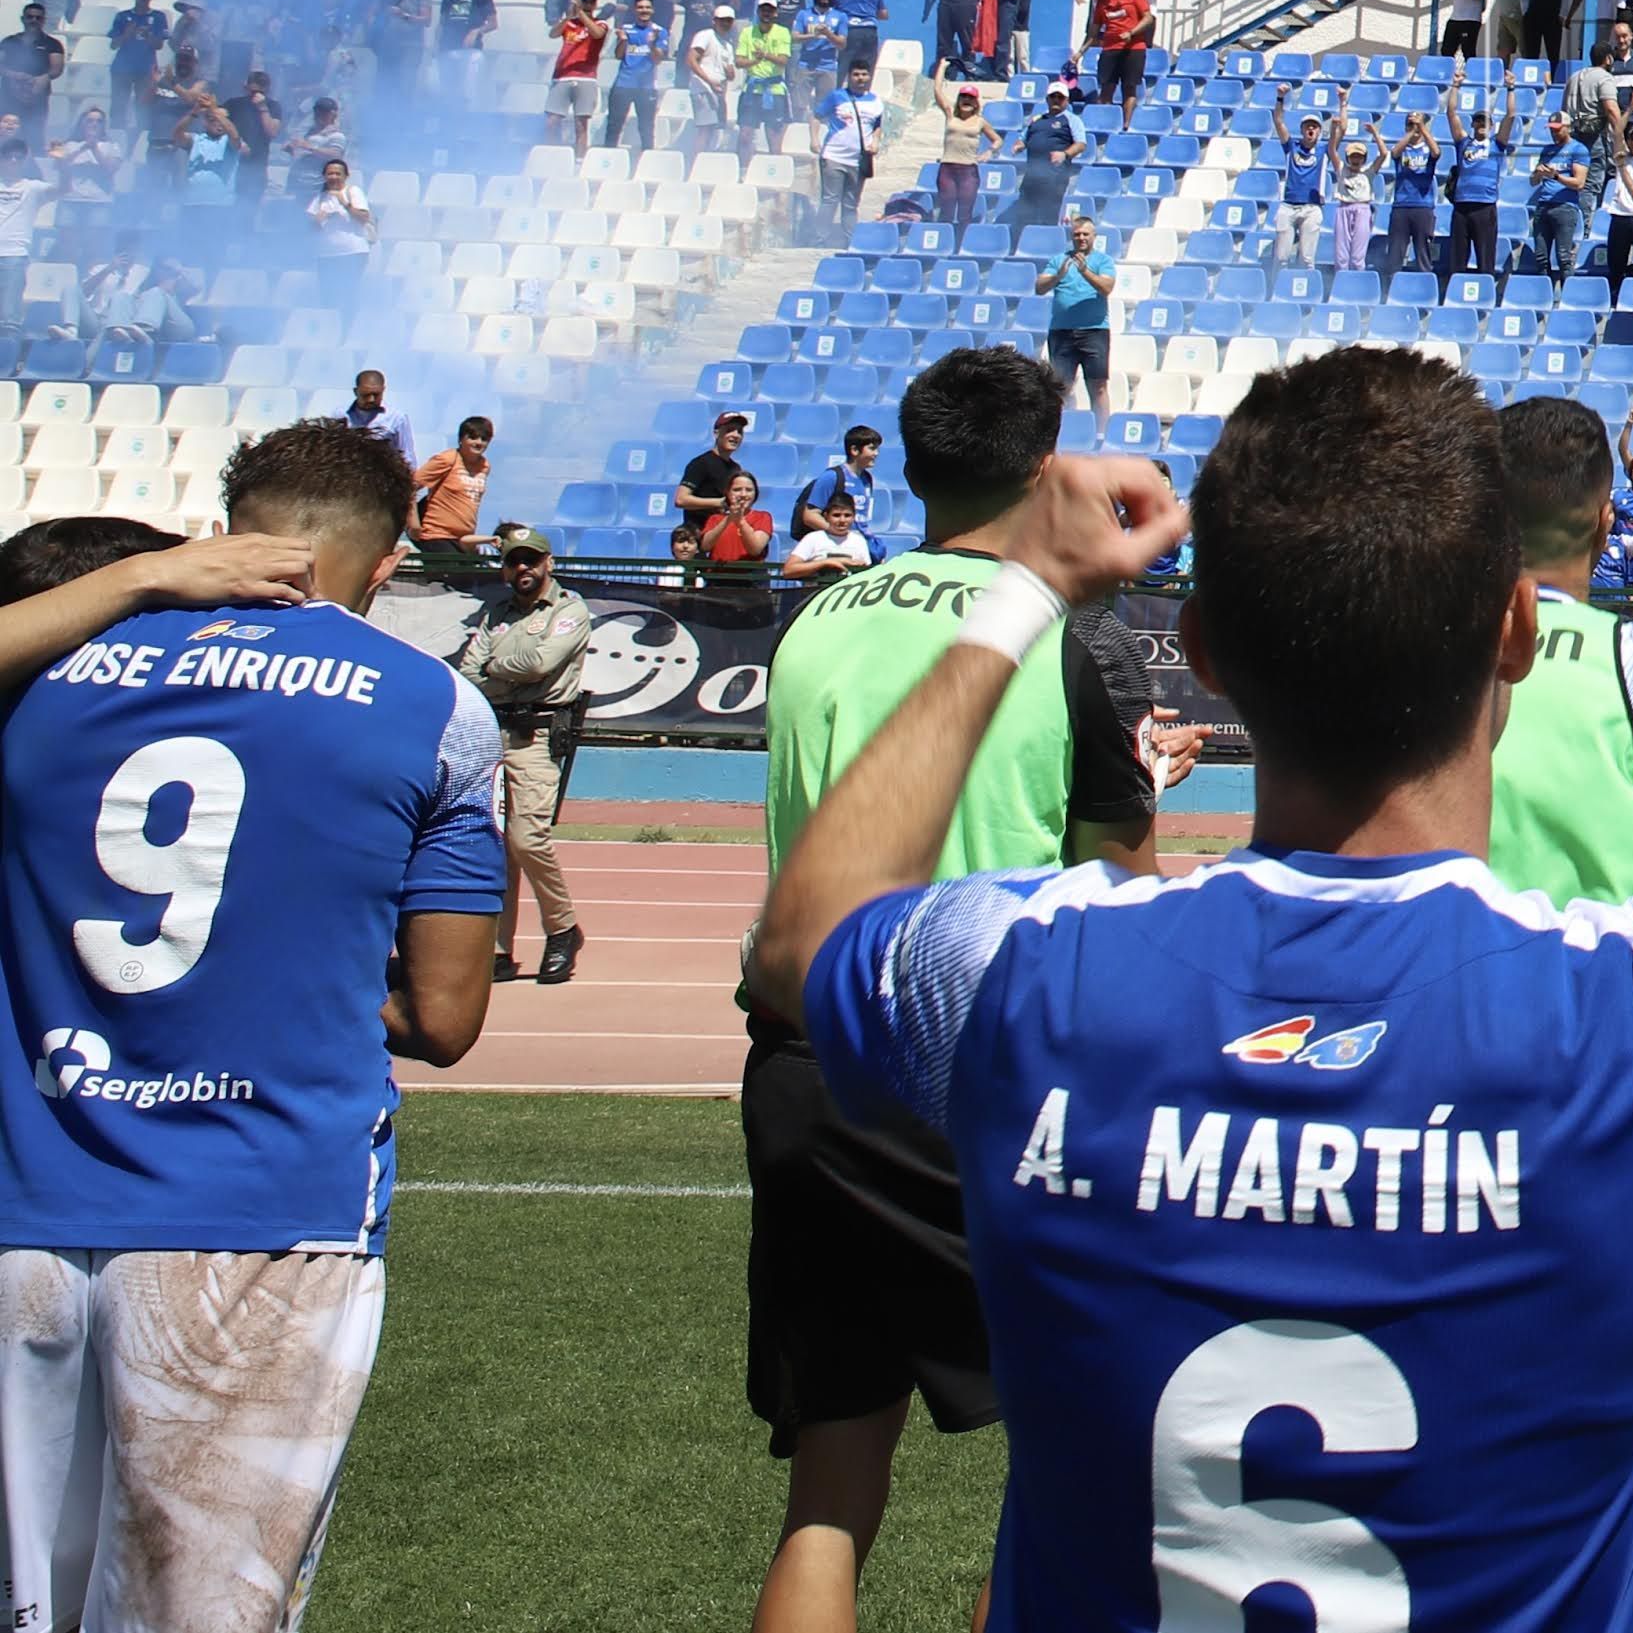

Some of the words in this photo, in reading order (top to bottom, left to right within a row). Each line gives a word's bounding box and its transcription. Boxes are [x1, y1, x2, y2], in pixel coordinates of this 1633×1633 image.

[47, 641, 166, 689] JOSE
[164, 645, 383, 706] ENRIQUE
[72, 735, 247, 995] 9
[79, 1071, 255, 1110] serglobin
[1012, 1087, 1093, 1199] A.
[1135, 1103, 1522, 1235] MARTÍN
[1151, 1318, 1419, 1633] 6
